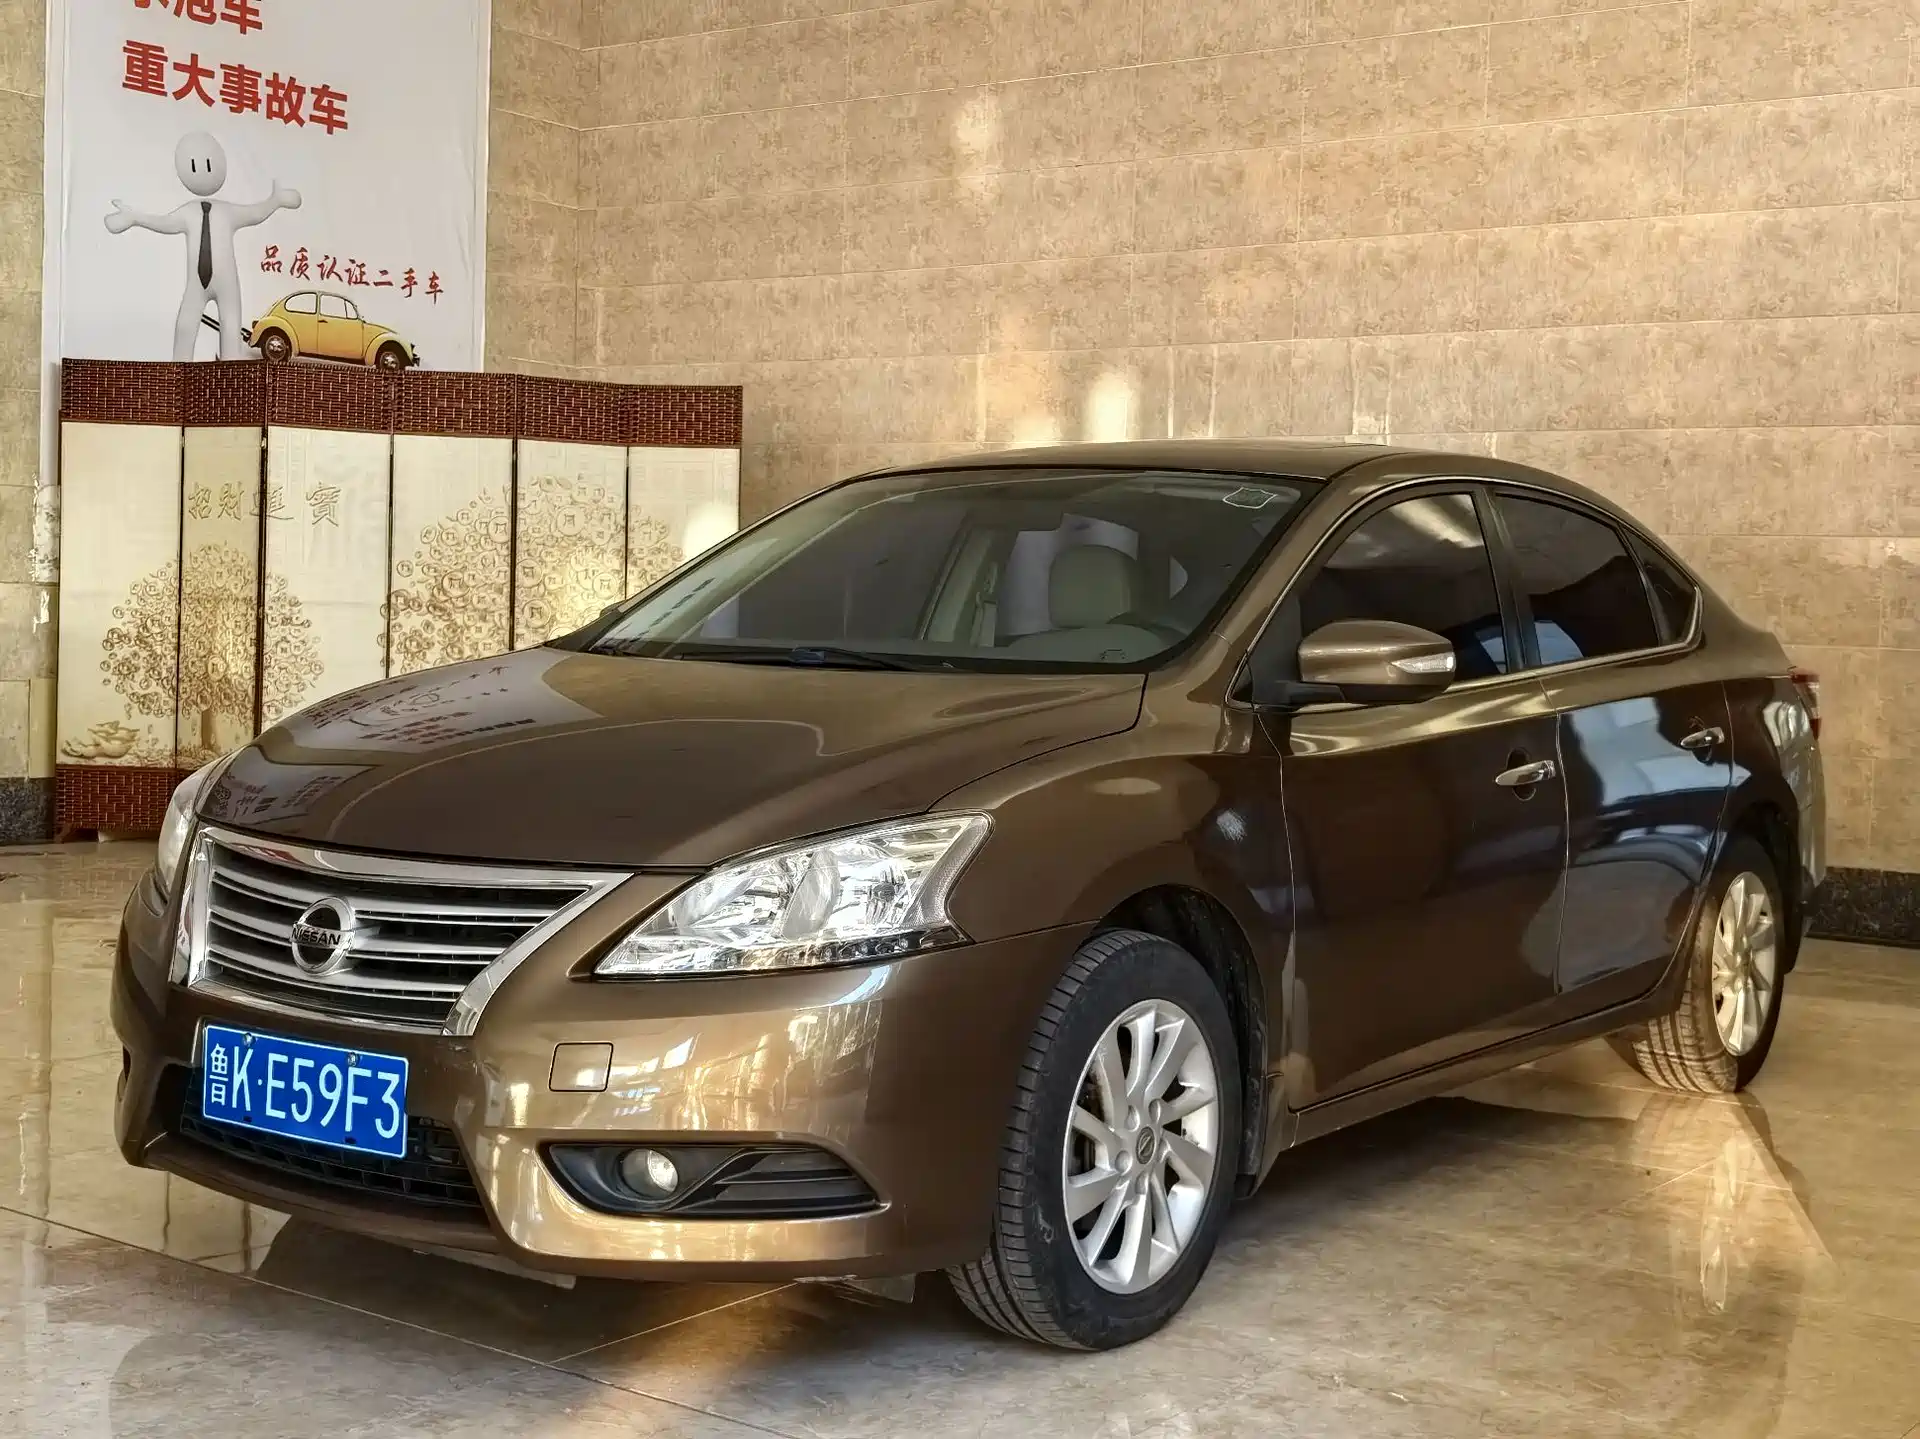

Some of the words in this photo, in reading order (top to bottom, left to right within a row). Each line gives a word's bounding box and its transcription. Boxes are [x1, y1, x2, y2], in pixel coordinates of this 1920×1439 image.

[122, 39, 348, 135] 重大事故车
[260, 244, 444, 305] 品质认证二手车
[292, 927, 341, 946] NISSAN
